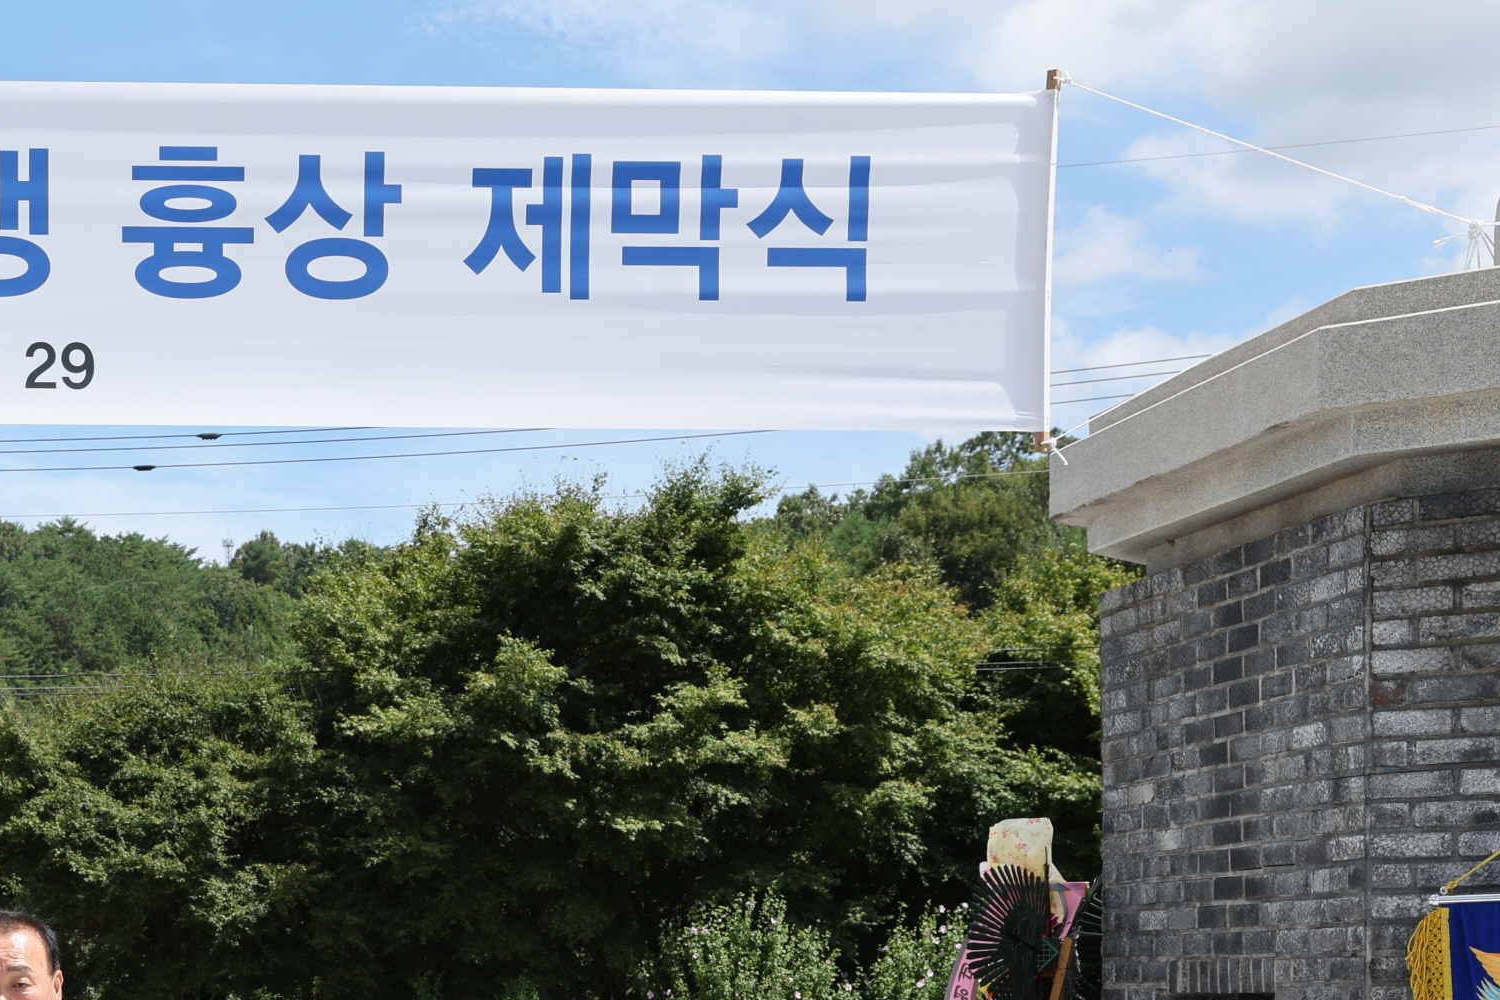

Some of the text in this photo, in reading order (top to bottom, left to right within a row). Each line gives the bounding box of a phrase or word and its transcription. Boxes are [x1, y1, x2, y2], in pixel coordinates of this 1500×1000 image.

[122, 146, 402, 300] 흉상
[463, 154, 871, 302] 제막식
[26, 342, 94, 389] 29
